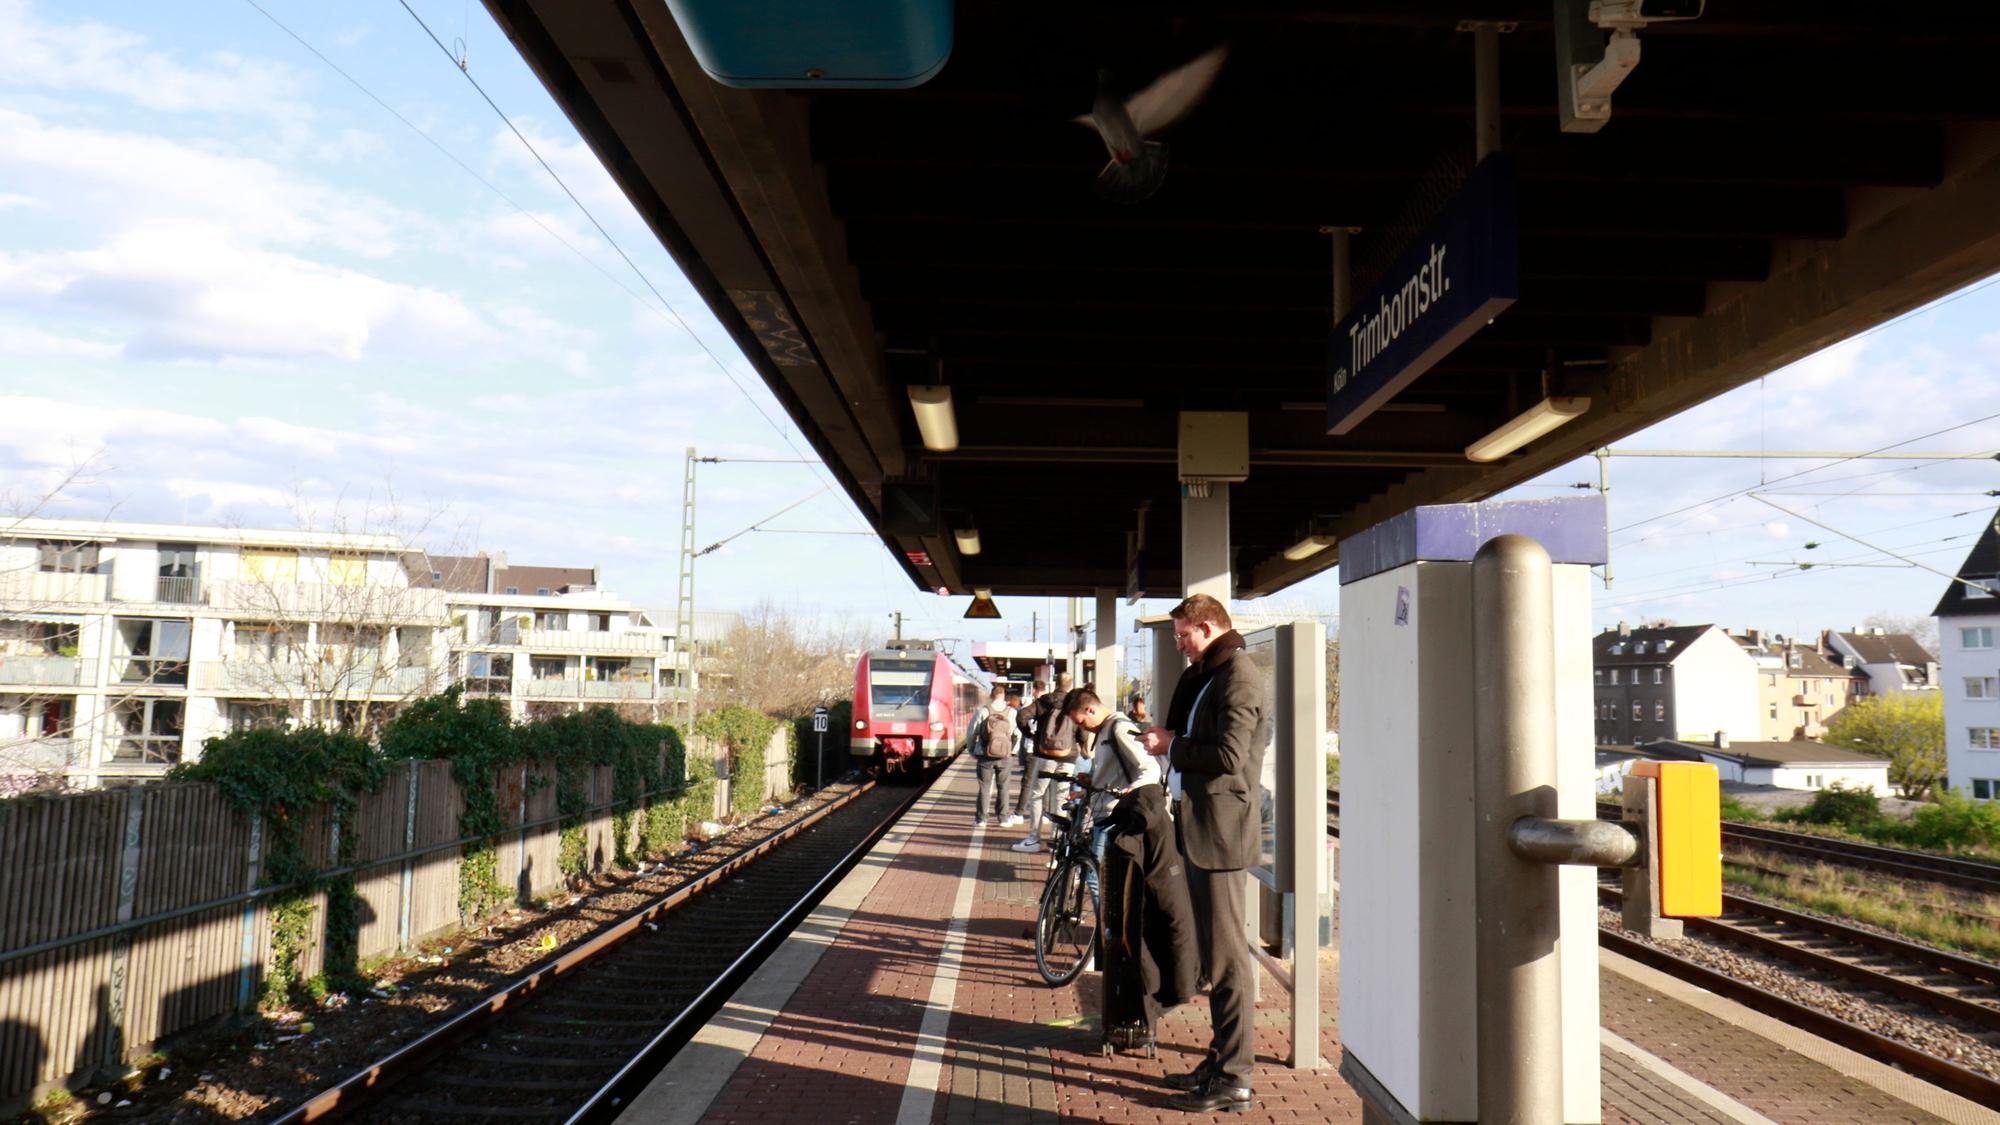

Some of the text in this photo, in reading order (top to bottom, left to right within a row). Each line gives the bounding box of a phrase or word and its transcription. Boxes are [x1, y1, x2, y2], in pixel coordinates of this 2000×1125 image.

[1333, 243, 1450, 394] Köln Trimbornstr.
[815, 715, 827, 730] 10
